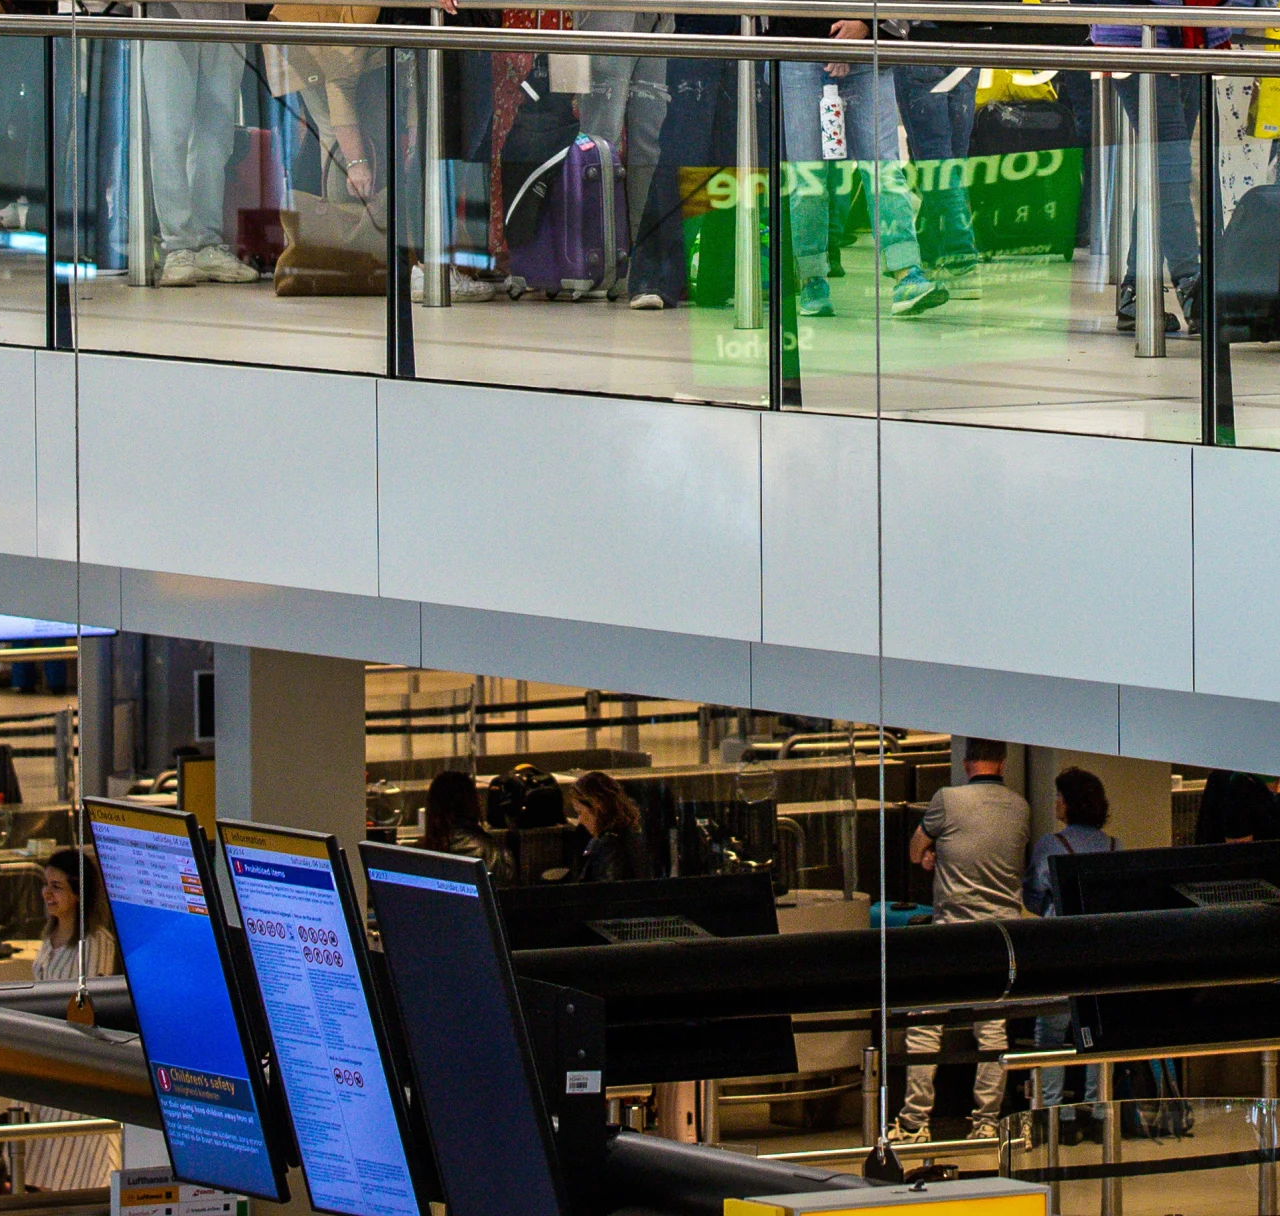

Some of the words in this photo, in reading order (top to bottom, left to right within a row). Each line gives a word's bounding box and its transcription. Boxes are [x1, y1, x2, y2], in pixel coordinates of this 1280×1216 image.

[231, 831, 266, 846] Information
[244, 863, 271, 876] Prohibited
[270, 867, 286, 879] items
[170, 1068, 209, 1087] Children's
[209, 1077, 235, 1096] safety
[127, 1175, 169, 1186] Lufthansa
